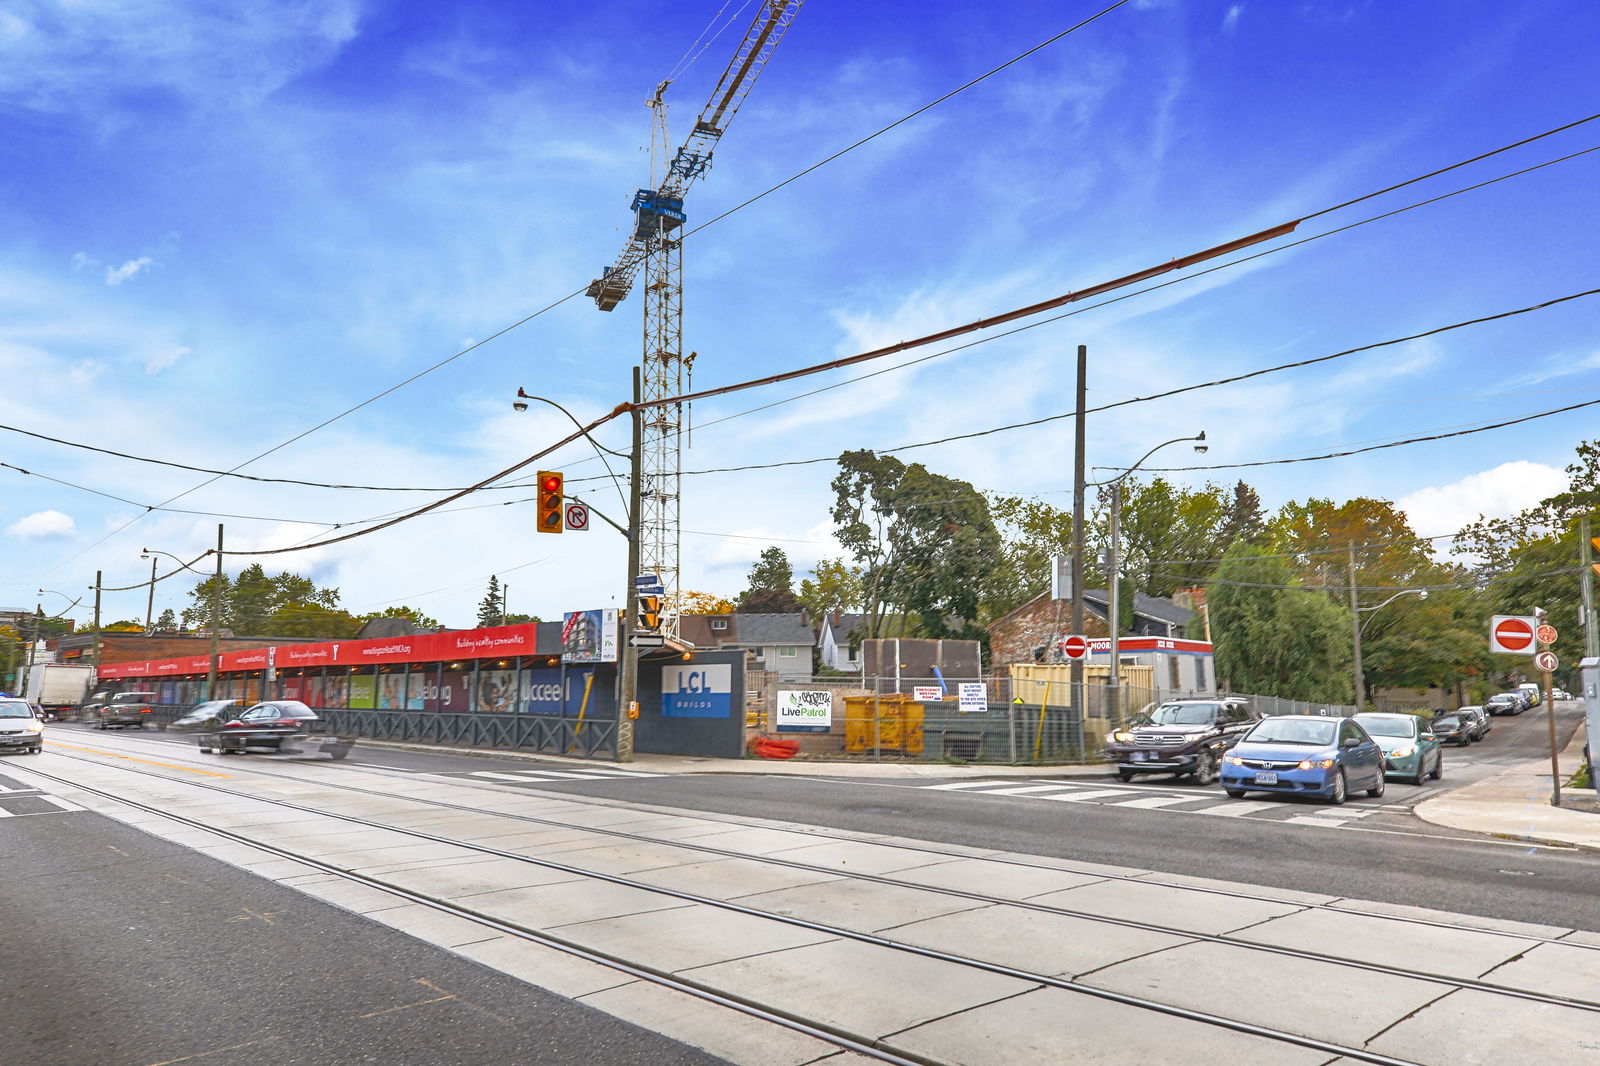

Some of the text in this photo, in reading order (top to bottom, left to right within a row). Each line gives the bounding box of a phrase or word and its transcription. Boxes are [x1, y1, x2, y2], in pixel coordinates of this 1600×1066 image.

[494, 633, 524, 646] communities
[1090, 641, 1111, 650] MOOR
[678, 671, 711, 694] LCL
[677, 701, 712, 709] BUILDS
[782, 707, 827, 717] LivePatrol
